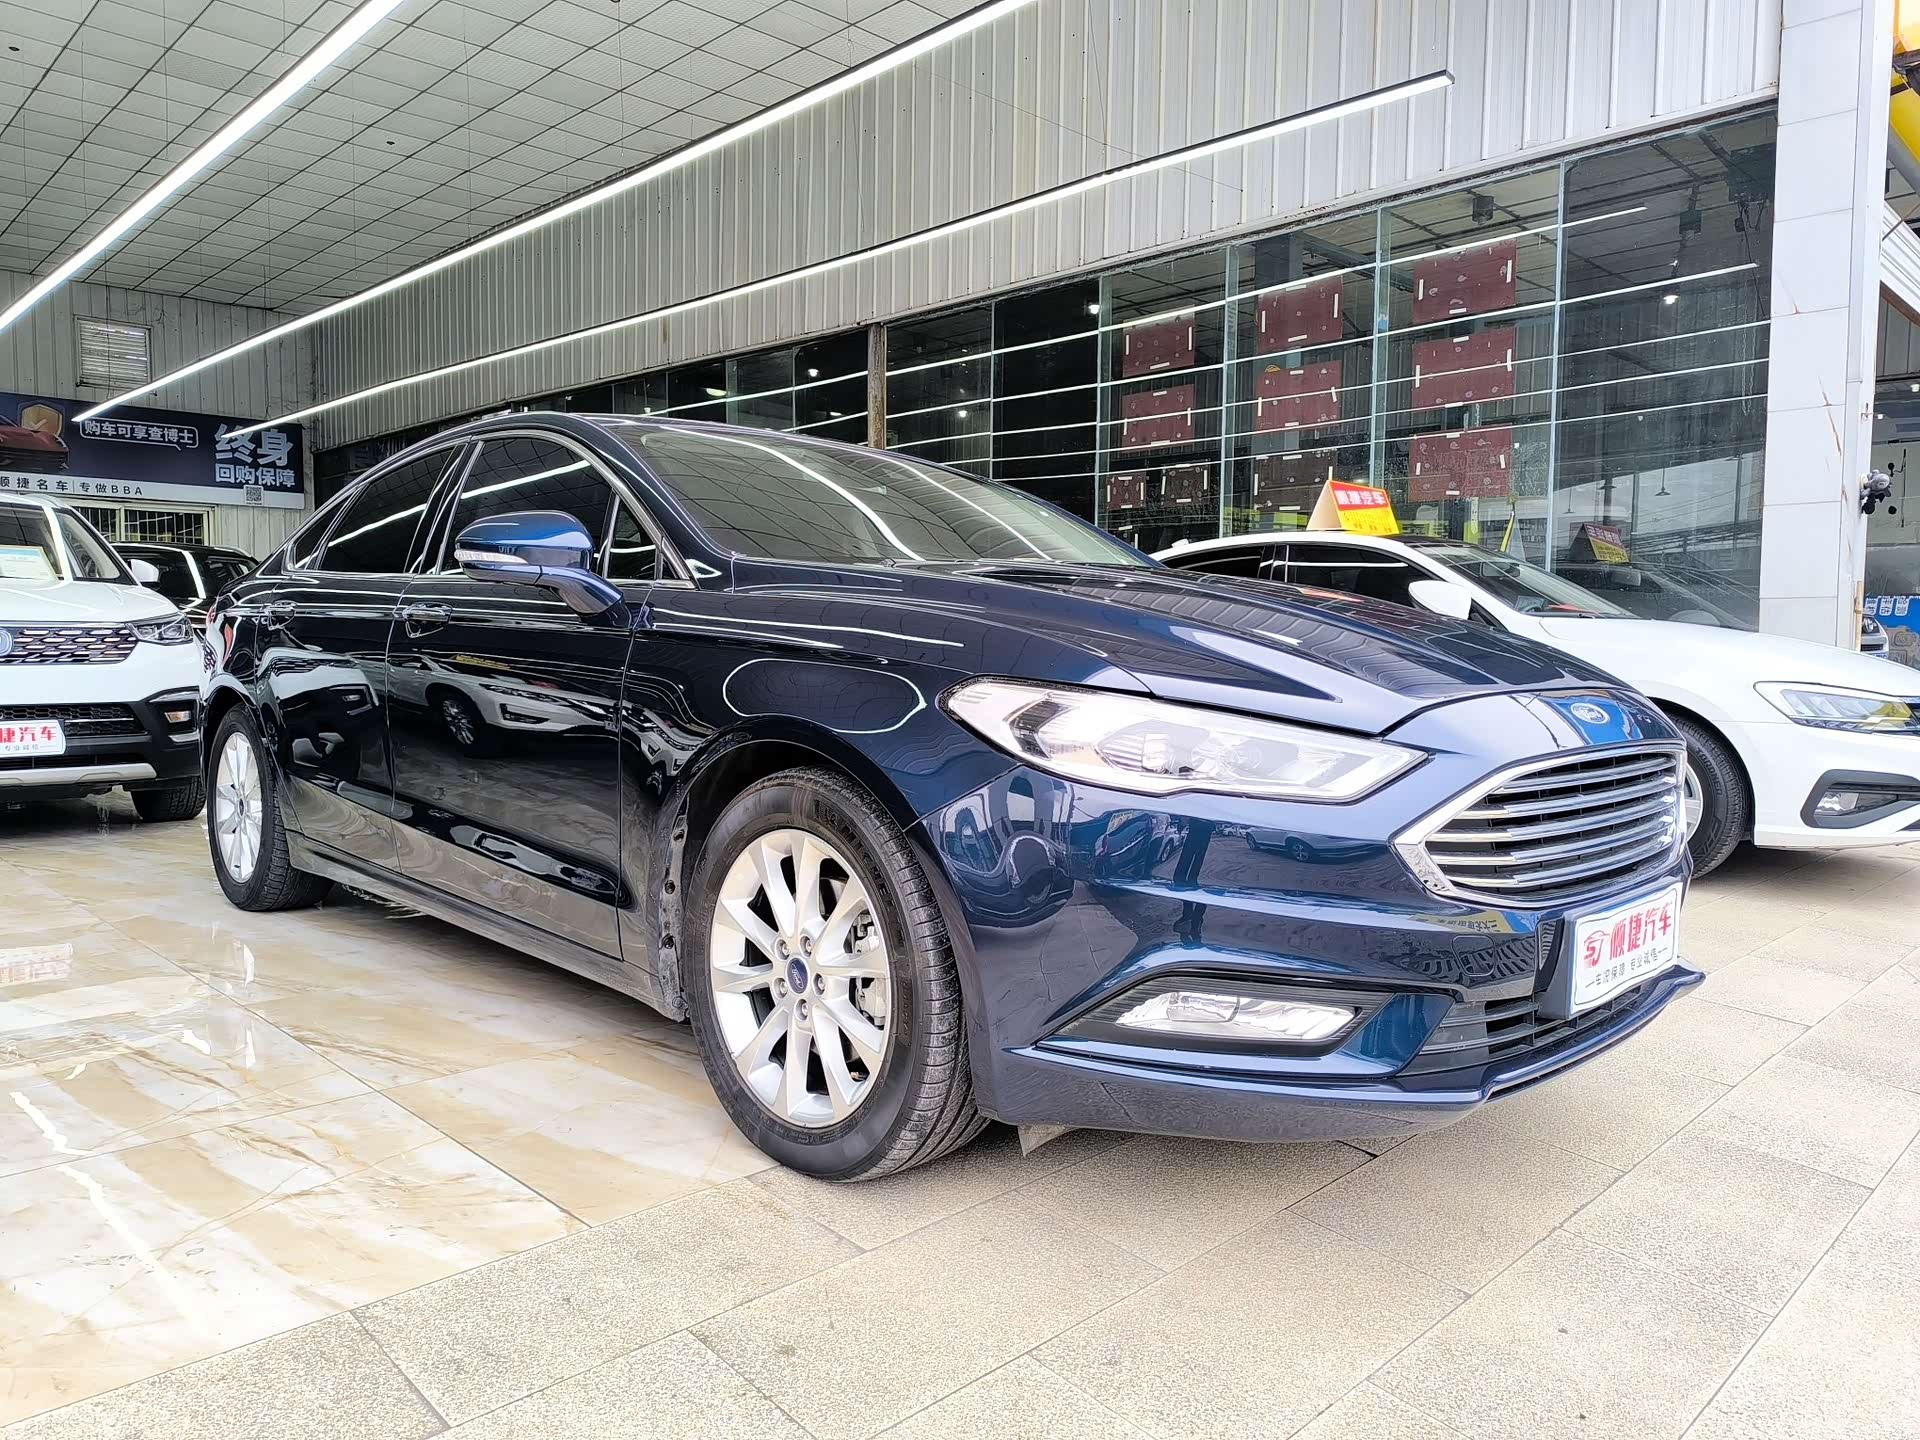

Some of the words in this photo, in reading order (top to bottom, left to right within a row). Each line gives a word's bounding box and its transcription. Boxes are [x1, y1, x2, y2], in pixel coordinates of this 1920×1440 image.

[84, 420, 194, 443] 购车可享查博士
[214, 423, 294, 467] 终身
[215, 463, 296, 487] 回购保障
[1610, 902, 1672, 960] 顺捷汽车
